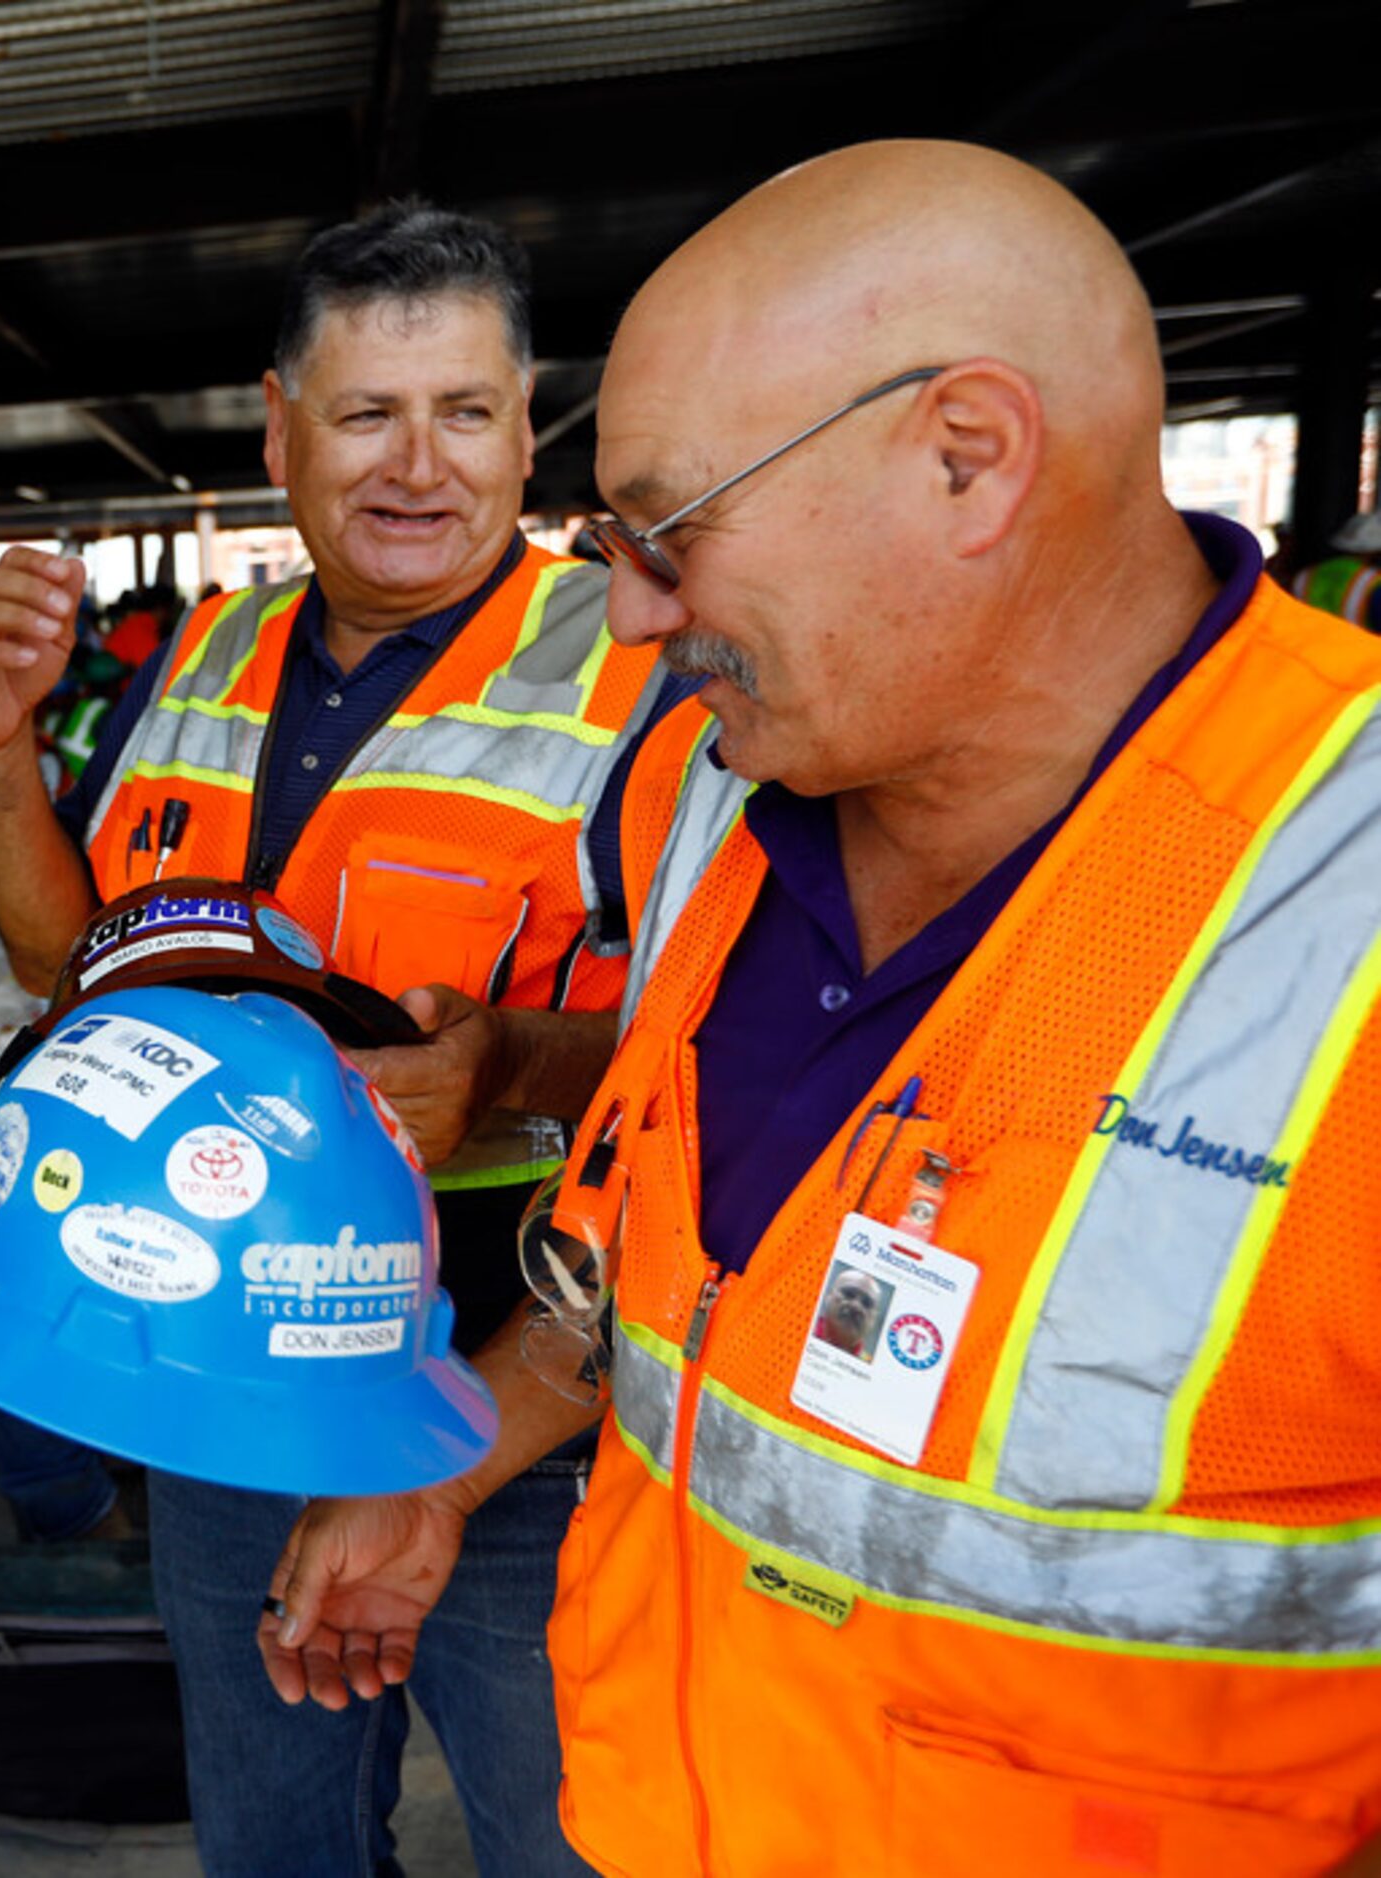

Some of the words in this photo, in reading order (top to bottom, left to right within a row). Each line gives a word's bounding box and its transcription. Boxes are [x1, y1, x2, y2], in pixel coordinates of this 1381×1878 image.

[80, 1053, 114, 1075] West
[110, 1069, 155, 1097] JPMC
[130, 1036, 195, 1078] KDC
[1092, 1093, 1159, 1148] Don
[1156, 1115, 1289, 1188] Jensen
[179, 1180, 251, 1200] TOYOTA
[240, 1224, 422, 1301] capform
[876, 1248, 958, 1294] Manhattan
[282, 1331, 330, 1350] DON
[332, 1326, 399, 1350] JENSEN
[789, 1588, 845, 1619] SAFETY
